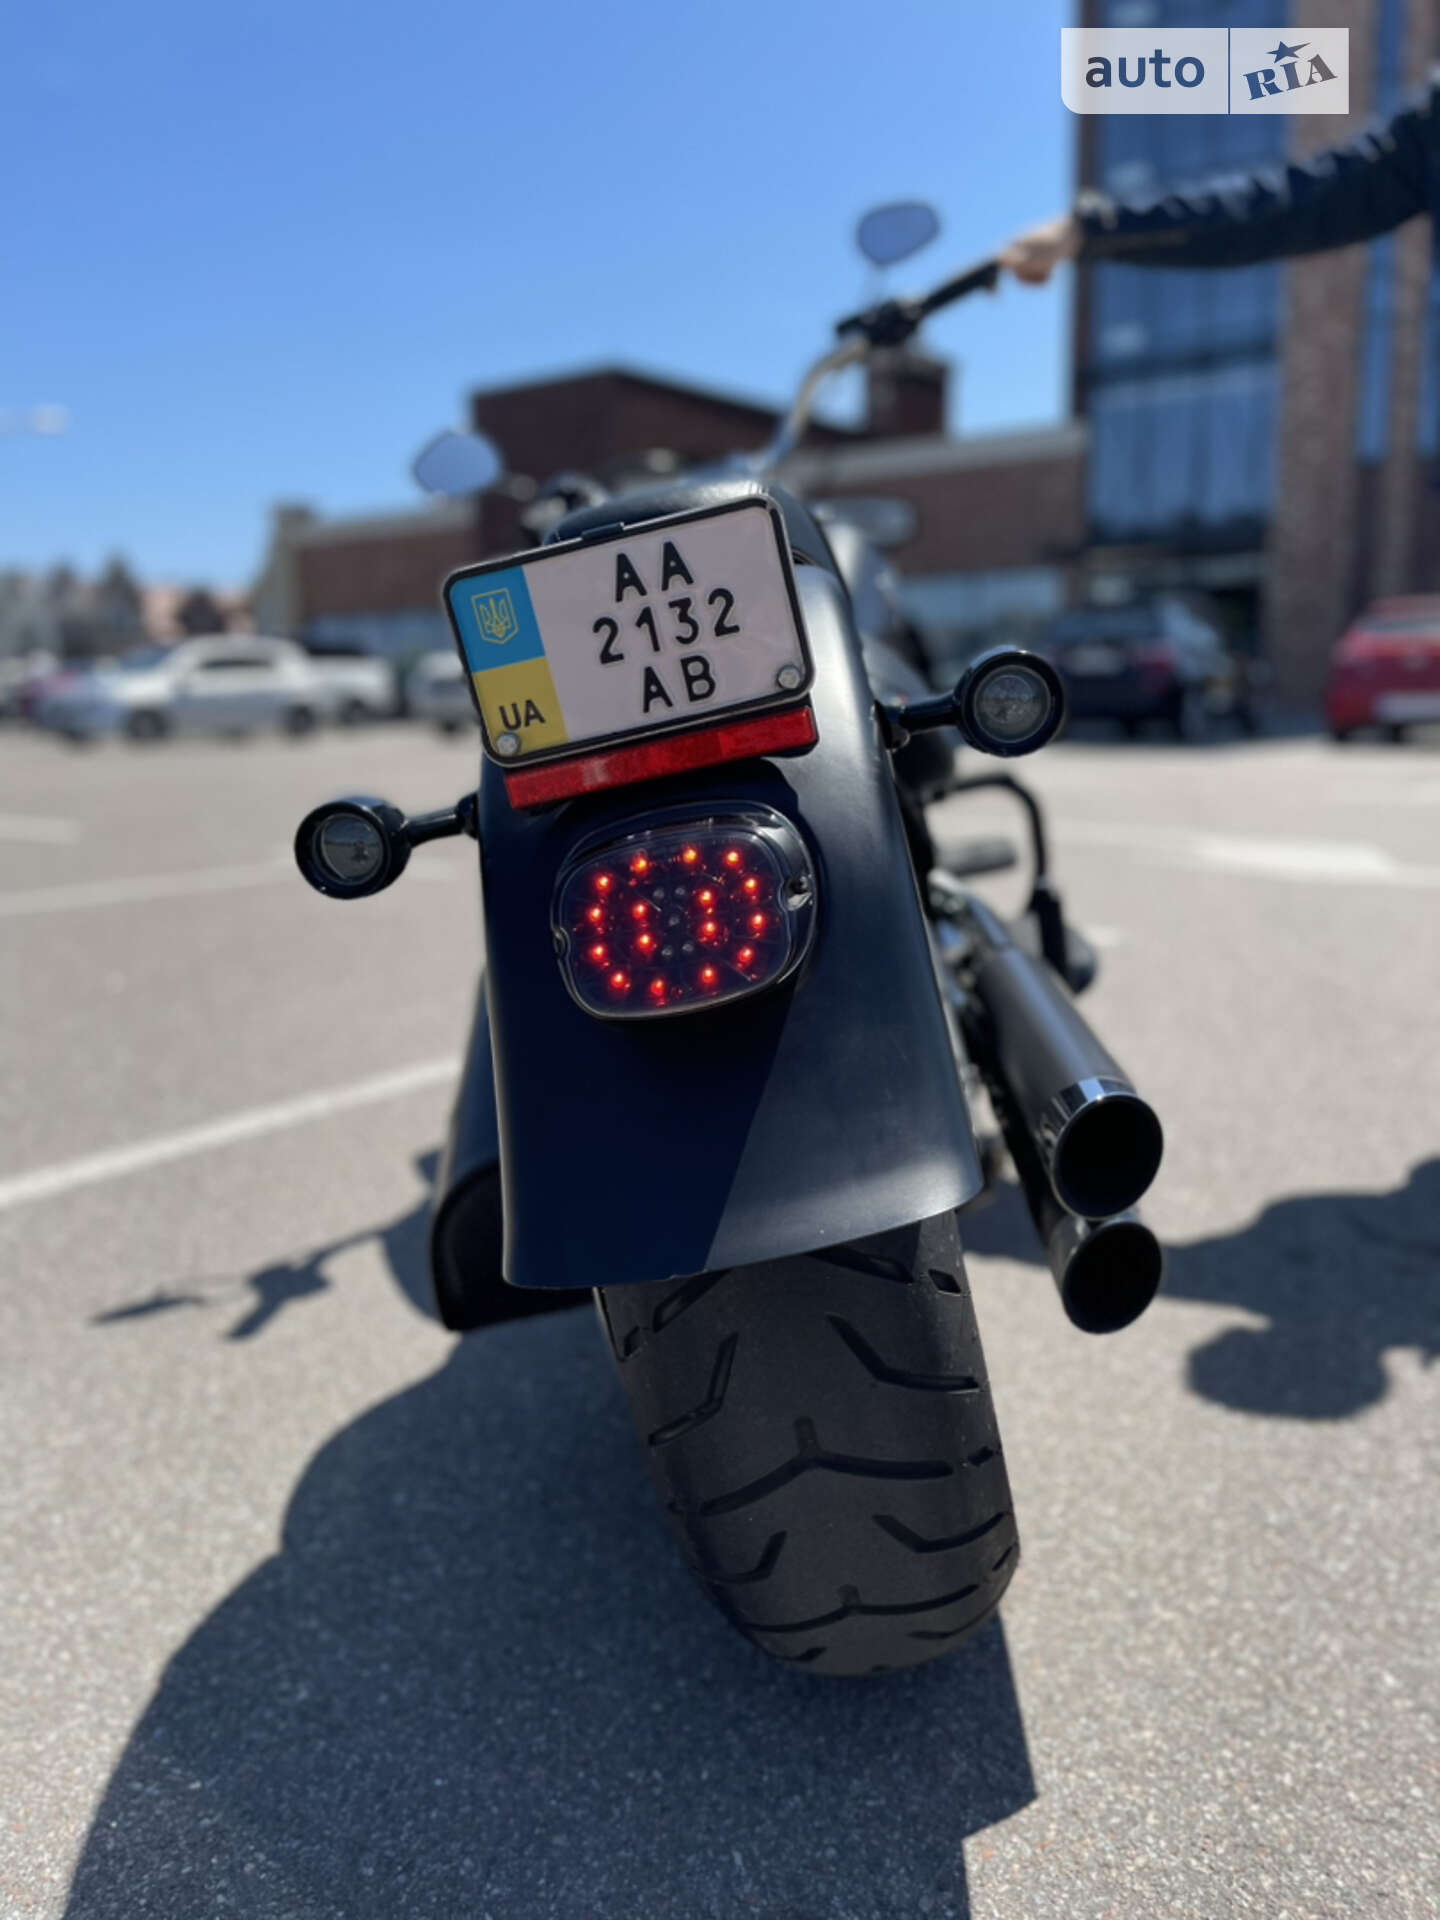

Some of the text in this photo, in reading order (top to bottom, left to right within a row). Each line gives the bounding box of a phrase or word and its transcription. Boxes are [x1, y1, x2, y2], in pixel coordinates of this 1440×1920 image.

[615, 541, 694, 602] AA
[592, 588, 740, 664] 2132
[642, 655, 716, 713] AB
[499, 700, 546, 731] UA
